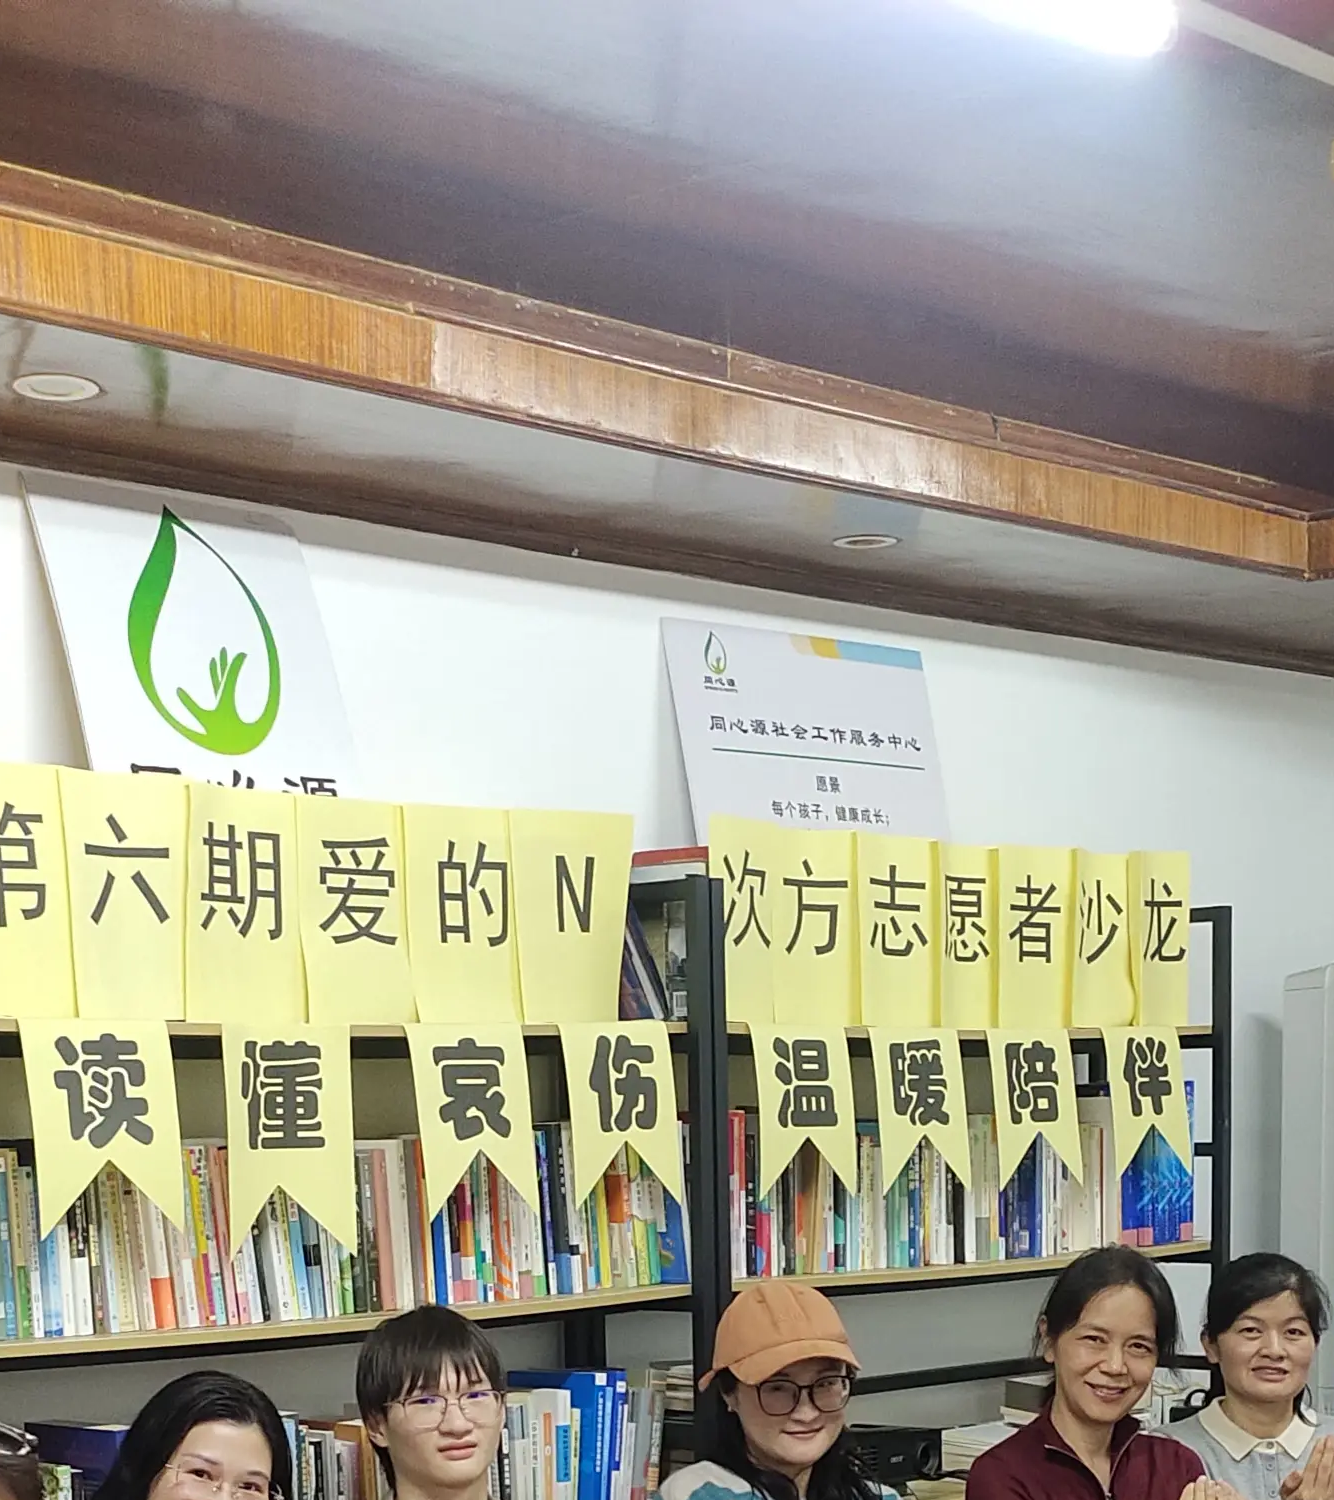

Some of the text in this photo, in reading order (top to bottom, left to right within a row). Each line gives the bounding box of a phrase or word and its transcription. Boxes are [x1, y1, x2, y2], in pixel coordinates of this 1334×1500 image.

[709, 715, 921, 752] 同心源社会工作服务中心
[816, 776, 841, 794] 愿景
